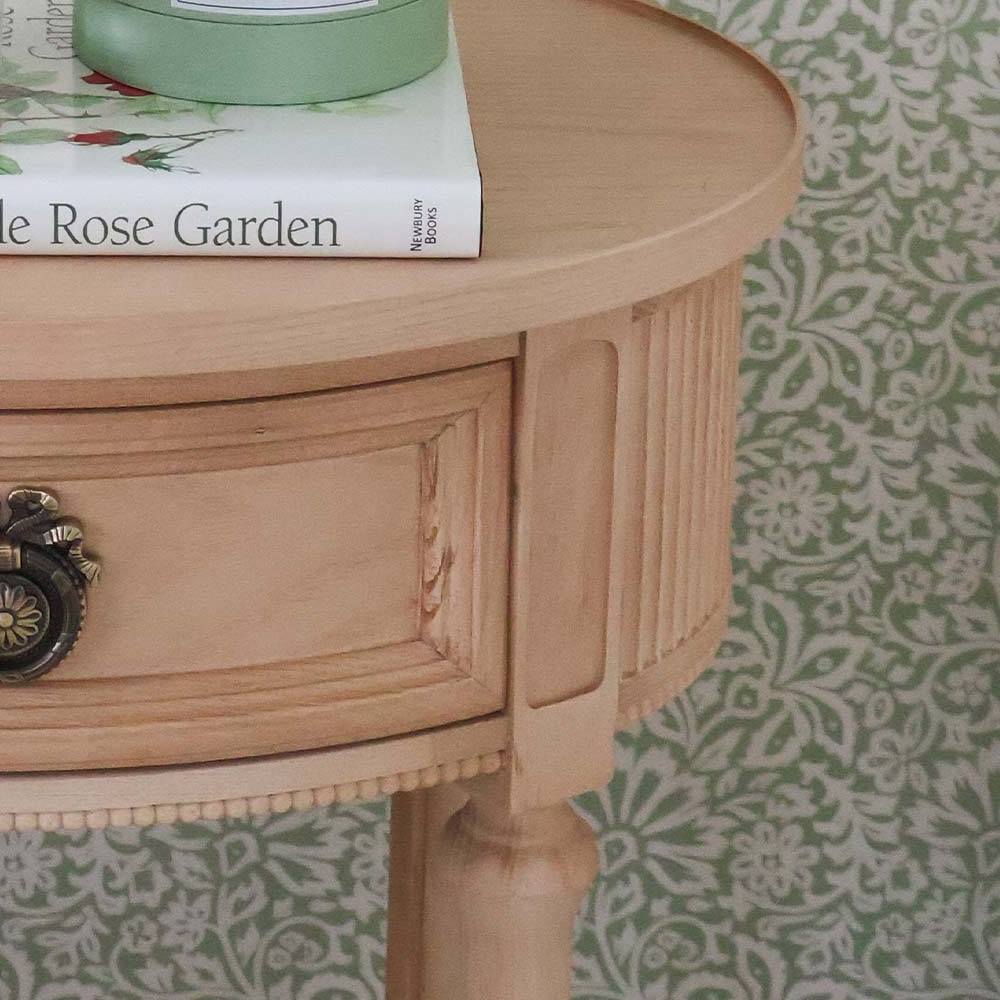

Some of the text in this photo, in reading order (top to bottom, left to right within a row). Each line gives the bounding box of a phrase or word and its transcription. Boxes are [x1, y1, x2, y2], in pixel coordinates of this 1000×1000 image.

[49, 203, 155, 247] Rose
[173, 201, 341, 247] Garden
[409, 198, 423, 252] NEWBURY
[424, 207, 438, 245] BOOKS
